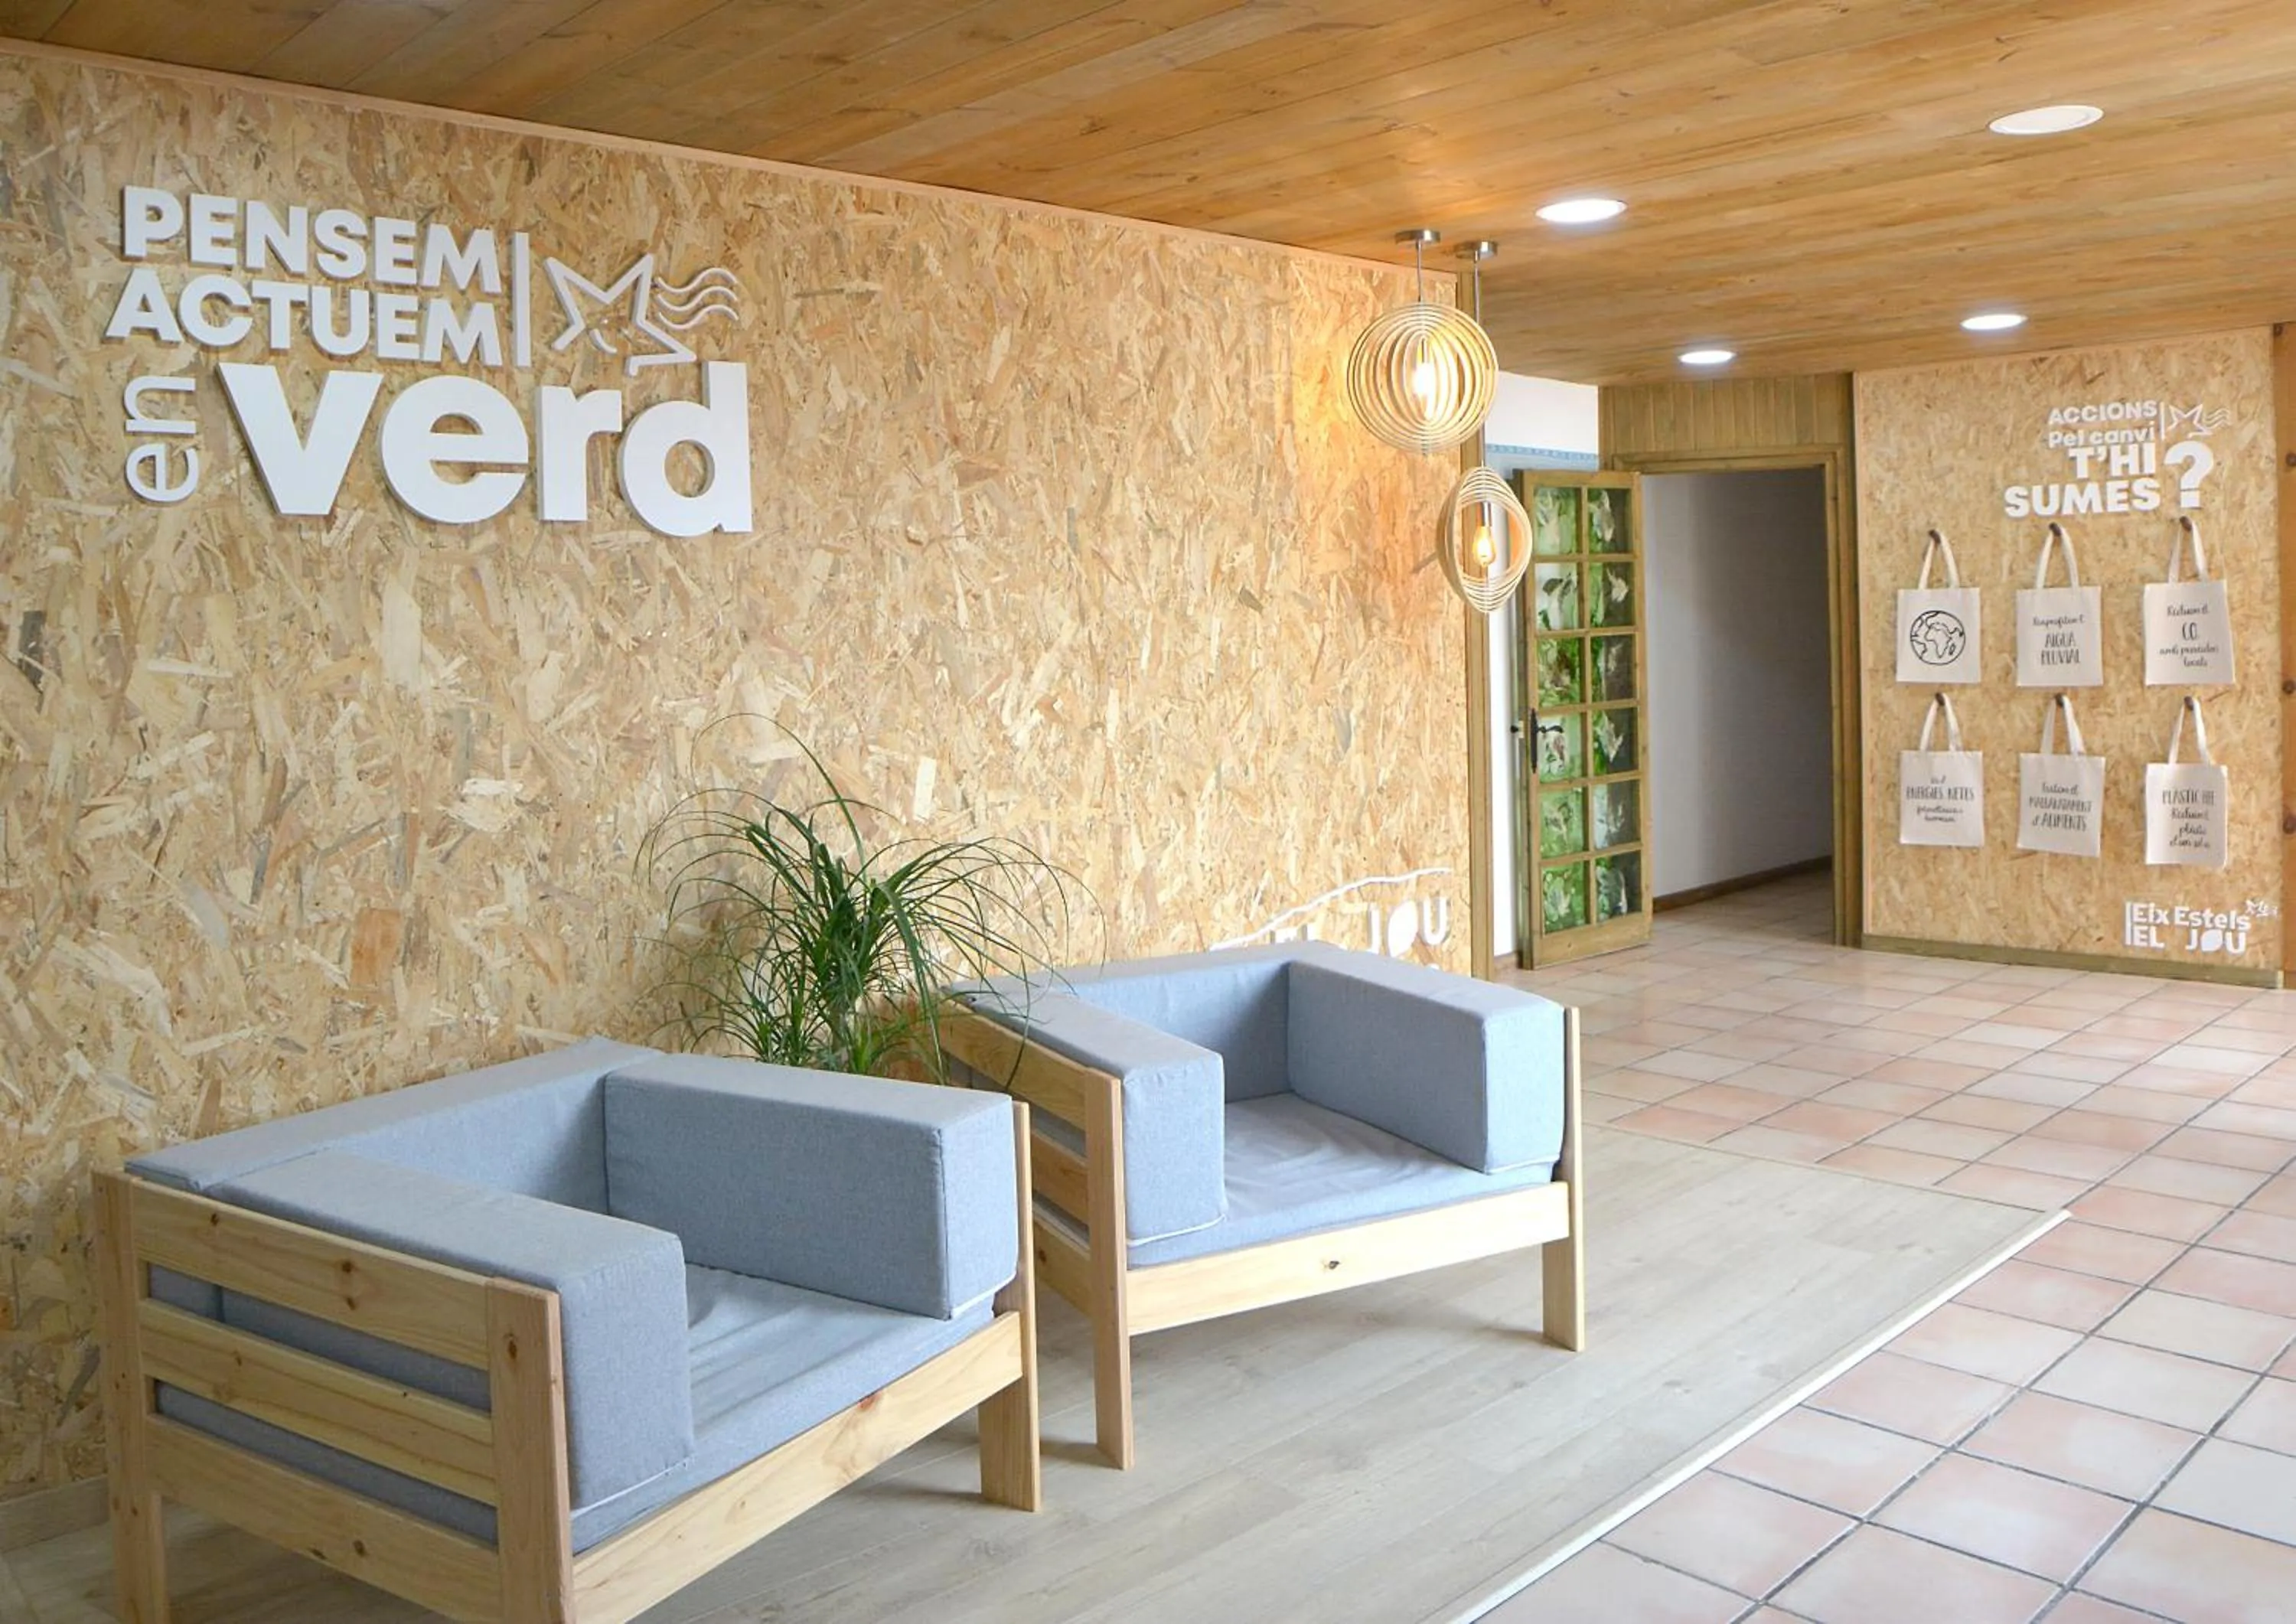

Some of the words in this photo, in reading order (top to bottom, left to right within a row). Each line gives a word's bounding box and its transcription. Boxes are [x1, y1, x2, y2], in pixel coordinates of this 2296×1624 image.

[123, 184, 502, 292] PENSEM
[104, 268, 502, 367] ACTUEM
[2048, 399, 2158, 426] ACCIONS
[123, 373, 200, 504] en
[2089, 420, 2155, 445] canvi
[2004, 477, 2161, 518] SUMES
[2132, 902, 2170, 925] Eix
[2174, 905, 2252, 931] Estels
[2134, 925, 2165, 949] EL
